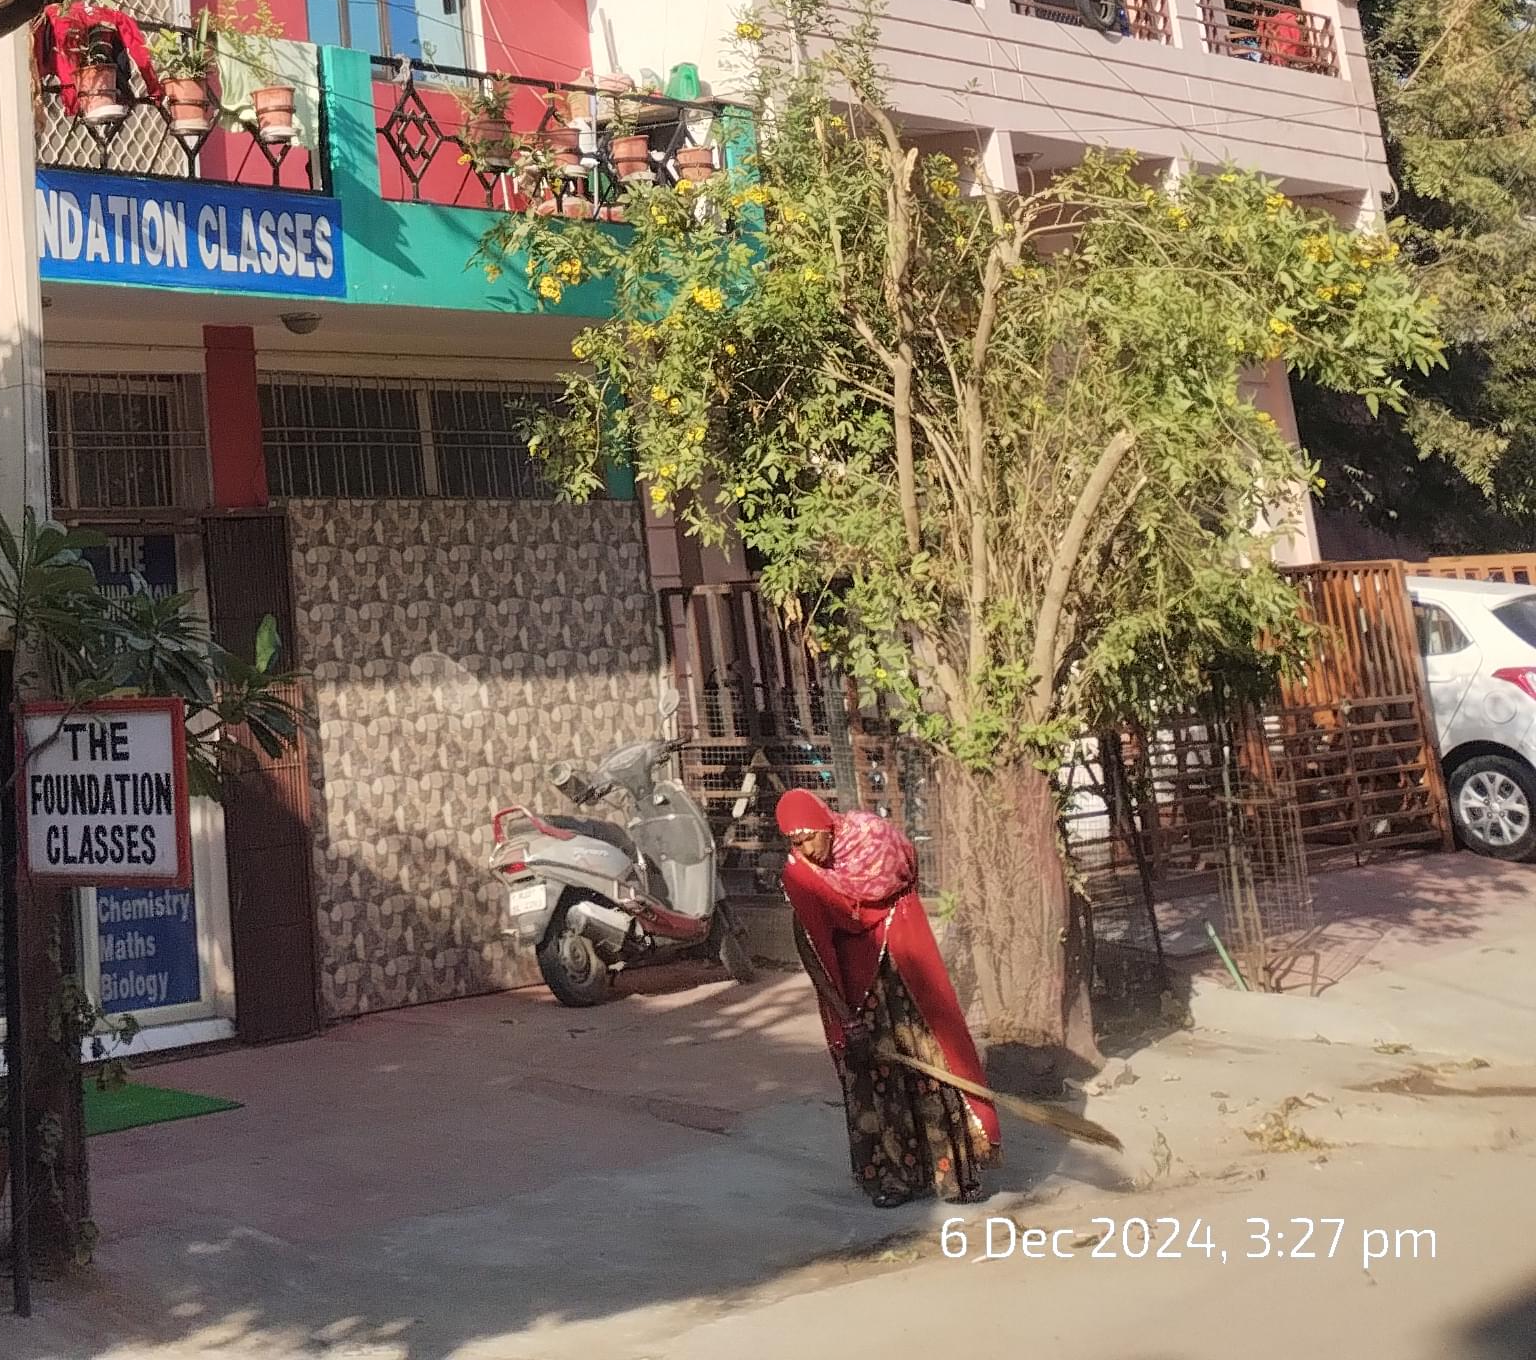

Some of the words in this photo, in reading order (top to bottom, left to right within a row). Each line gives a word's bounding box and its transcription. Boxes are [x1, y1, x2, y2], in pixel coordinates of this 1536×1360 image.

[198, 202, 333, 279] CLASSES
[64, 722, 130, 761] THE
[31, 772, 172, 815] FOUNDATION
[46, 824, 157, 865] CLASSES
[98, 889, 190, 923] Chemistry
[100, 931, 156, 962] Maths
[101, 970, 169, 1002] Biology
